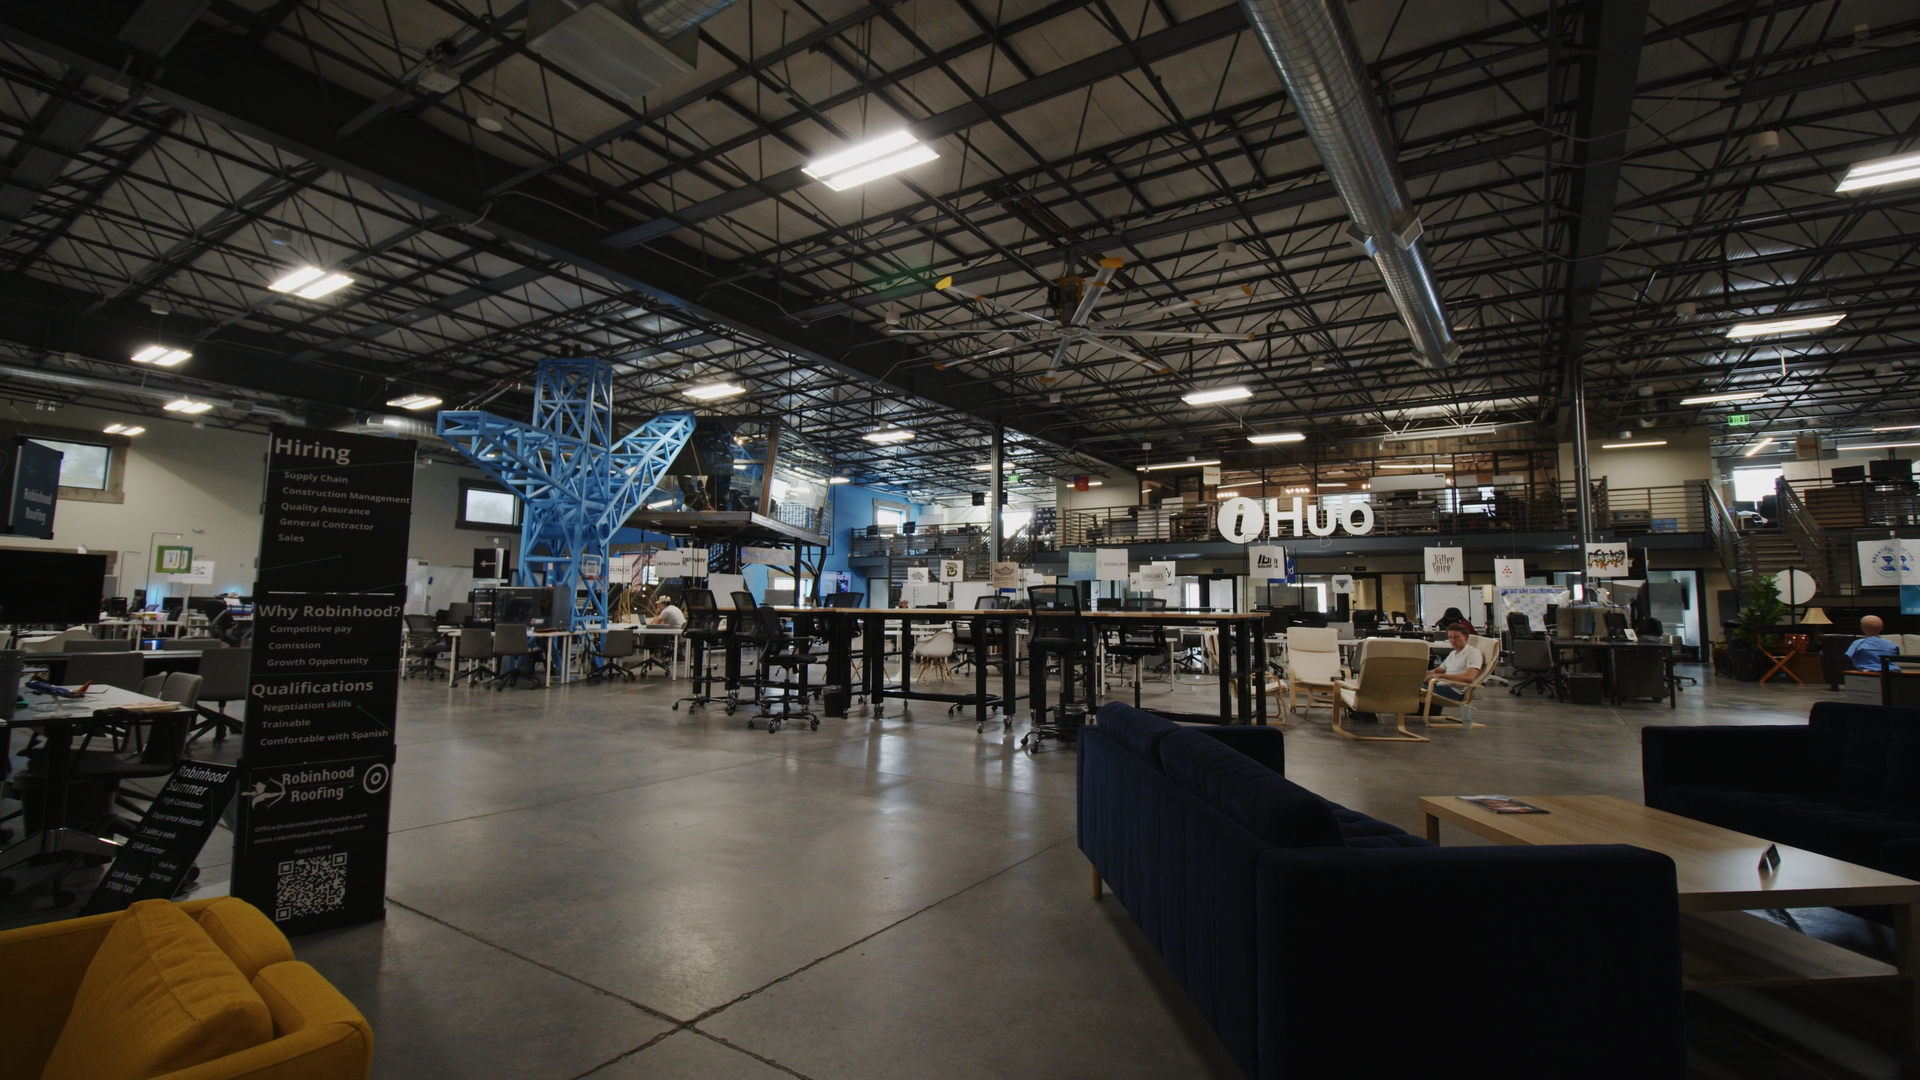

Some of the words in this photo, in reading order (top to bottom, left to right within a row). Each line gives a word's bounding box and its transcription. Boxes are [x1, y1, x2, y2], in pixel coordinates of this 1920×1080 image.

[274, 437, 351, 465] Hiring
[284, 471, 318, 483] Supply
[320, 474, 348, 484] Chain
[24, 488, 52, 506] Robinhood
[282, 486, 347, 499] Construction
[349, 491, 410, 504] Management
[281, 502, 318, 514] Quality
[320, 505, 371, 516] Assurance
[25, 507, 47, 526] Roofing
[279, 517, 320, 528] General
[322, 520, 374, 531] Contractor
[278, 533, 305, 543] Sales
[1434, 554, 1455, 565] Killer
[258, 605, 299, 620] Why
[303, 605, 401, 618] Robinhood?
[270, 625, 332, 635] Competitive
[334, 626, 352, 635] pay
[268, 641, 321, 650] Comission
[266, 658, 305, 667] Growth
[308, 657, 369, 667] Opportunity
[251, 680, 374, 698] Qualifications
[263, 701, 324, 713] Negotiation
[326, 700, 352, 709] skills
[262, 718, 311, 729] Trainable
[260, 732, 325, 746] Comfortable
[327, 731, 349, 742] with
[351, 729, 389, 741] Spanish
[176, 765, 230, 784] Robinhood
[282, 766, 355, 786] Robinhood
[166, 779, 209, 796] Summer
[290, 786, 344, 803] Roofing
[143, 844, 166, 855] Summer
[294, 846, 314, 855] Apply
[124, 872, 144, 886] Roofing
